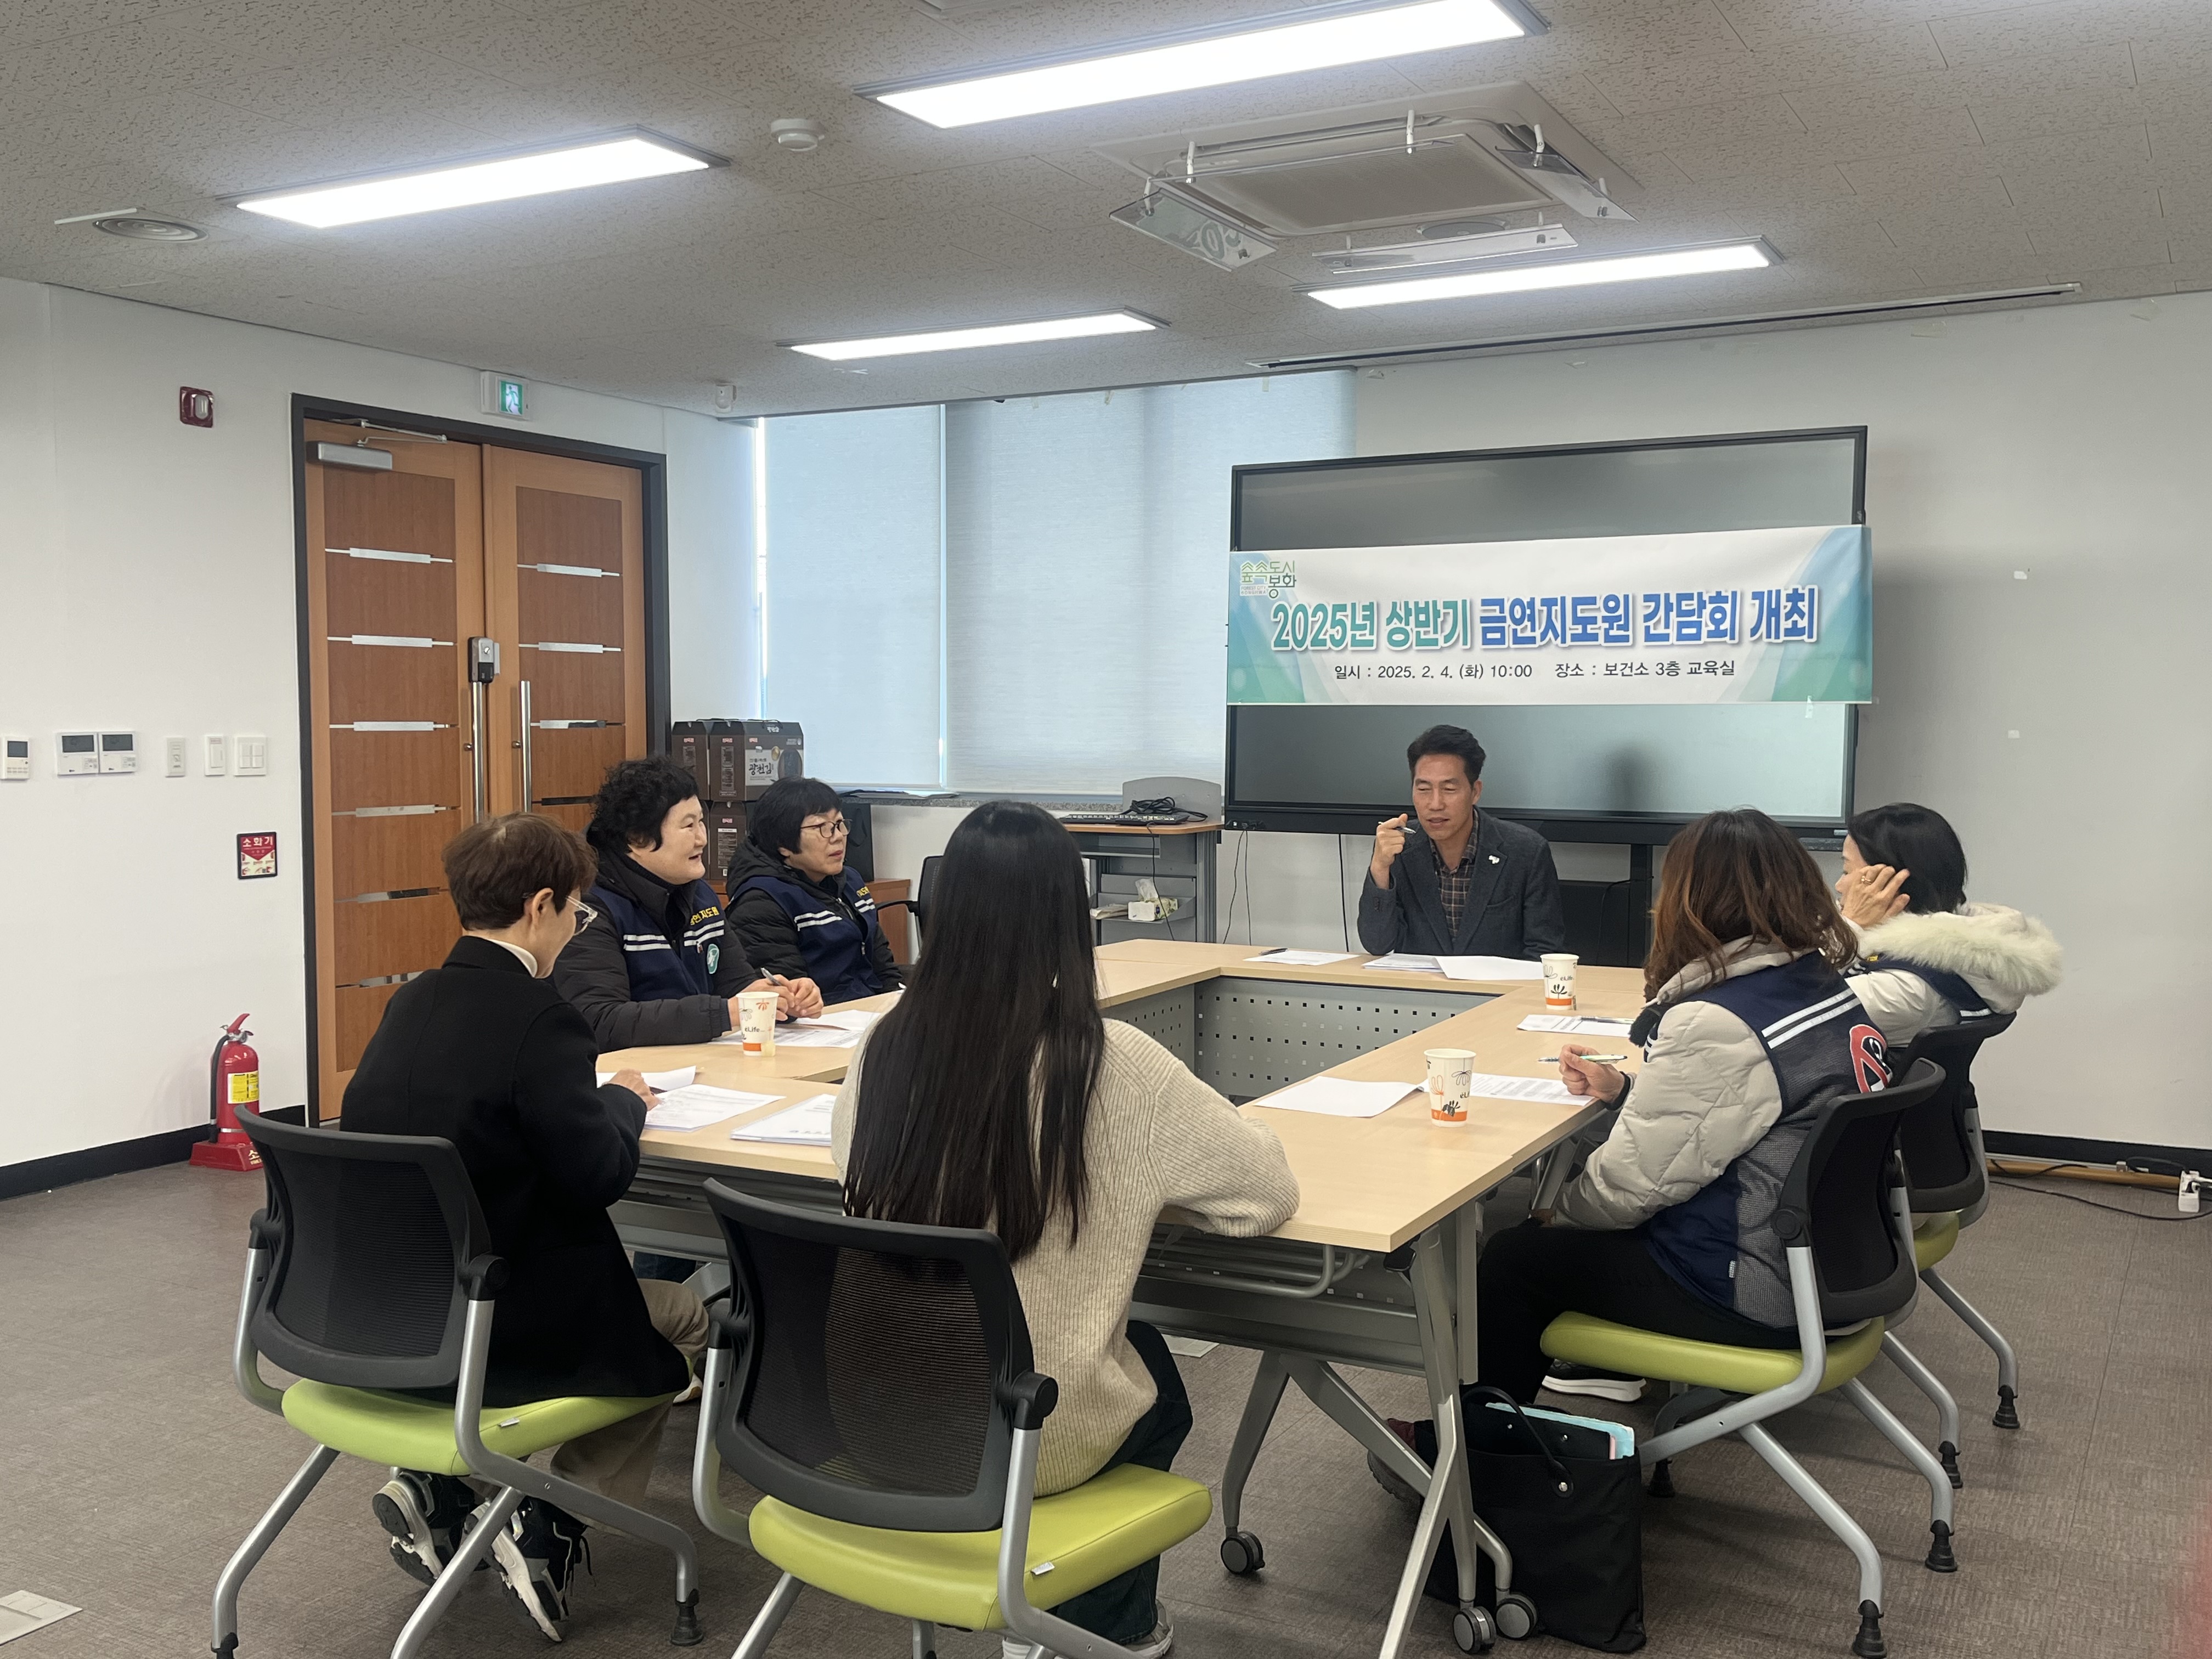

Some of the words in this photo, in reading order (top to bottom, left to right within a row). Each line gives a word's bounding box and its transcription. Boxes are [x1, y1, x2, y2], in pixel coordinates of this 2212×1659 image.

[1268, 573, 1297, 599] 봉화
[1272, 601, 1375, 648] 2025년
[1385, 599, 1468, 648] 상반기
[1480, 594, 1630, 646] 금연지도원
[1643, 590, 1737, 642] 간담회
[1750, 588, 1815, 640] 개최
[1335, 665, 1361, 680] 일시
[1378, 665, 1415, 679] 2025.
[1421, 665, 1434, 679] 2.
[1440, 665, 1453, 679] 4.
[1459, 664, 1483, 680] (화)
[1491, 664, 1532, 678] 10:00
[1555, 663, 1584, 678] 장소
[1603, 662, 1649, 676] 보건소
[1655, 661, 1681, 676] 3층
[1686, 660, 1735, 676] 교육실
[749, 763, 772, 775] 광천김
[242, 836, 273, 847] 소화기
